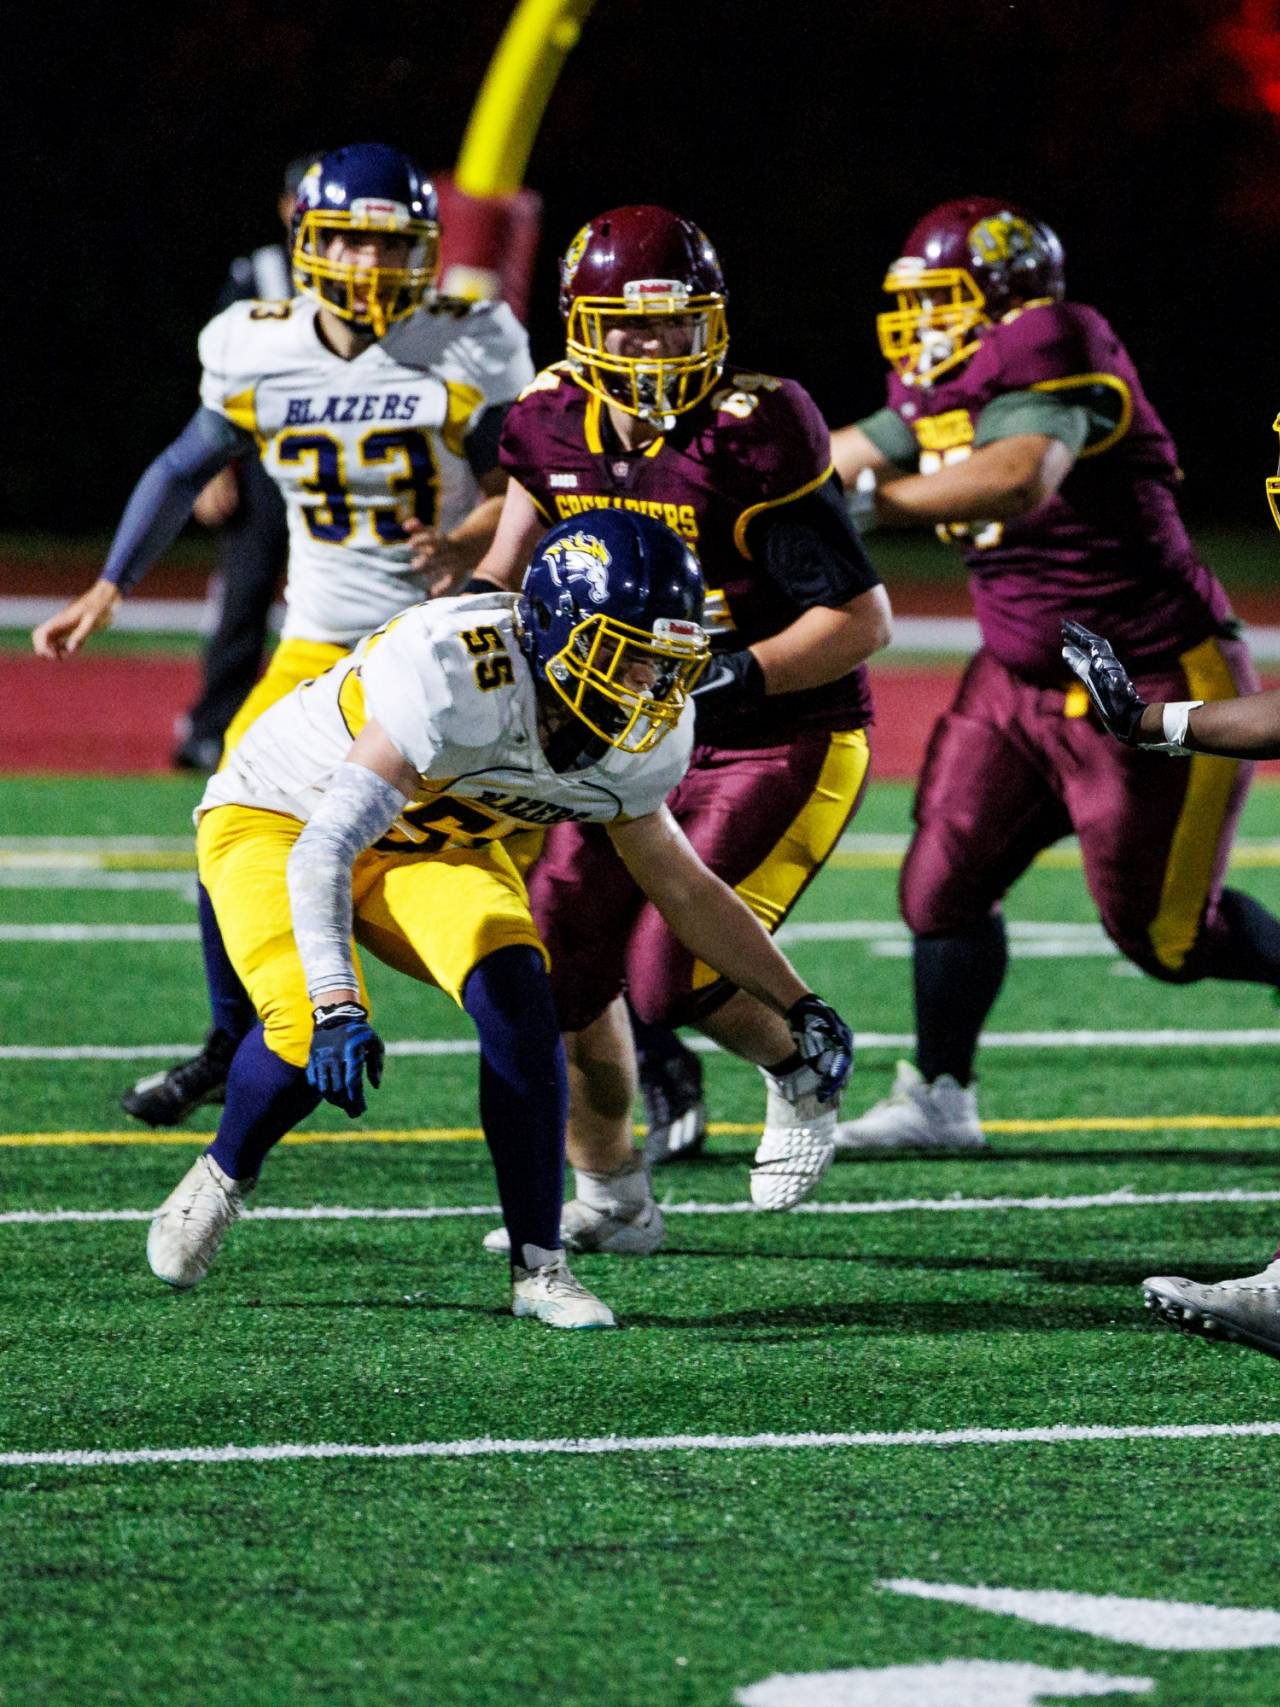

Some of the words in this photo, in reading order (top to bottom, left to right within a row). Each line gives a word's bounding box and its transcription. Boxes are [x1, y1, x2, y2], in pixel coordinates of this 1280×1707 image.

[284, 394, 420, 425] BLAZERS
[275, 426, 440, 545] 33
[459, 625, 516, 693] 55
